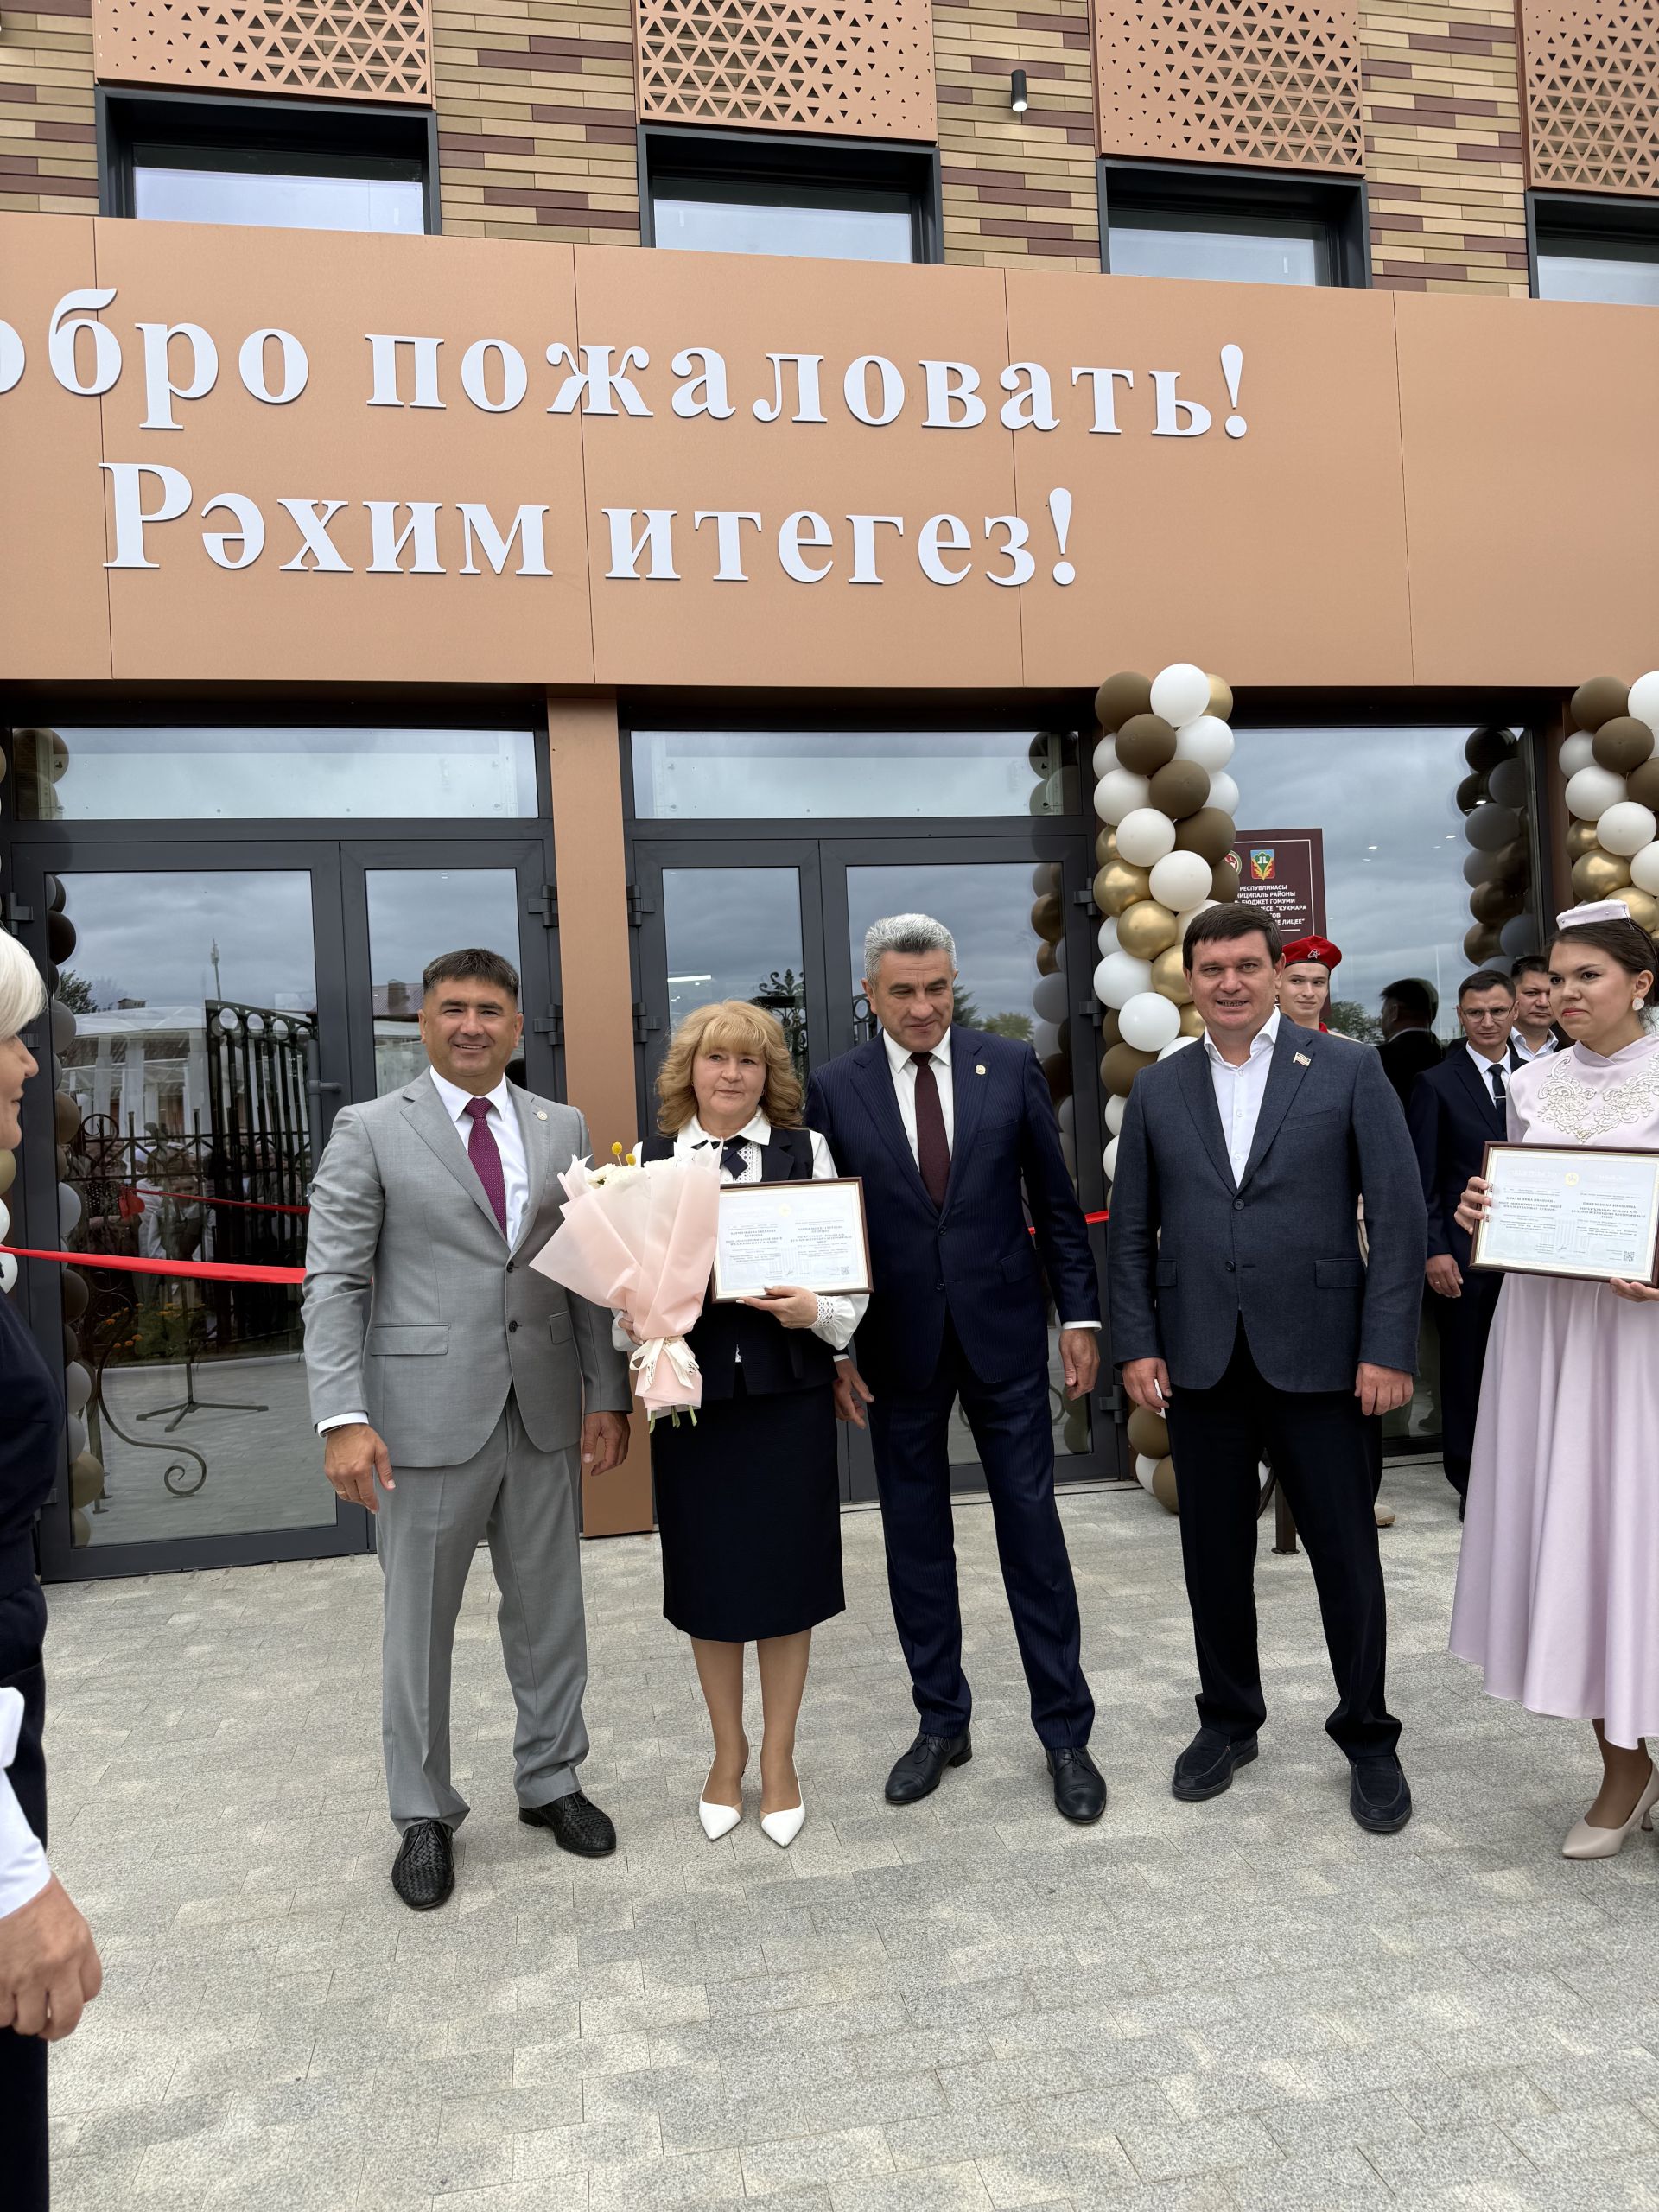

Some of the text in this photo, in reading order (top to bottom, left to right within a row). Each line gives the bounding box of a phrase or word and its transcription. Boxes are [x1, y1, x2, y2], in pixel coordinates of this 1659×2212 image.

[365, 333, 1248, 439] пожаловать!
[99, 462, 1076, 587] Рәхим итегез!
